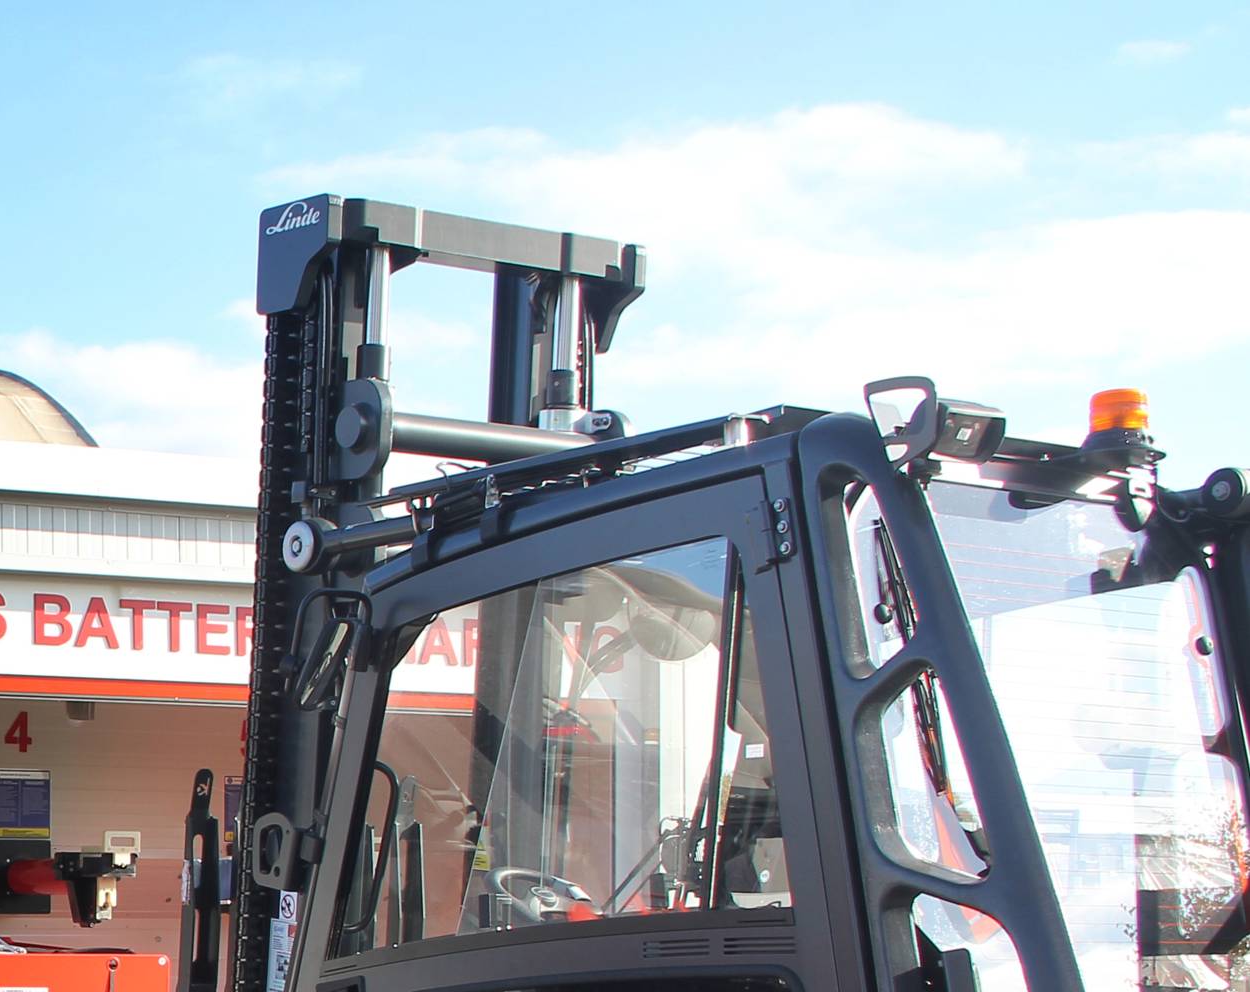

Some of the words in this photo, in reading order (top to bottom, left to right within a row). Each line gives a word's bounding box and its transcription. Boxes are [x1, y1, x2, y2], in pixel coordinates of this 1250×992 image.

[265, 201, 320, 235] Linde
[33, 593, 255, 657] BATTER
[3, 710, 33, 753] 4
